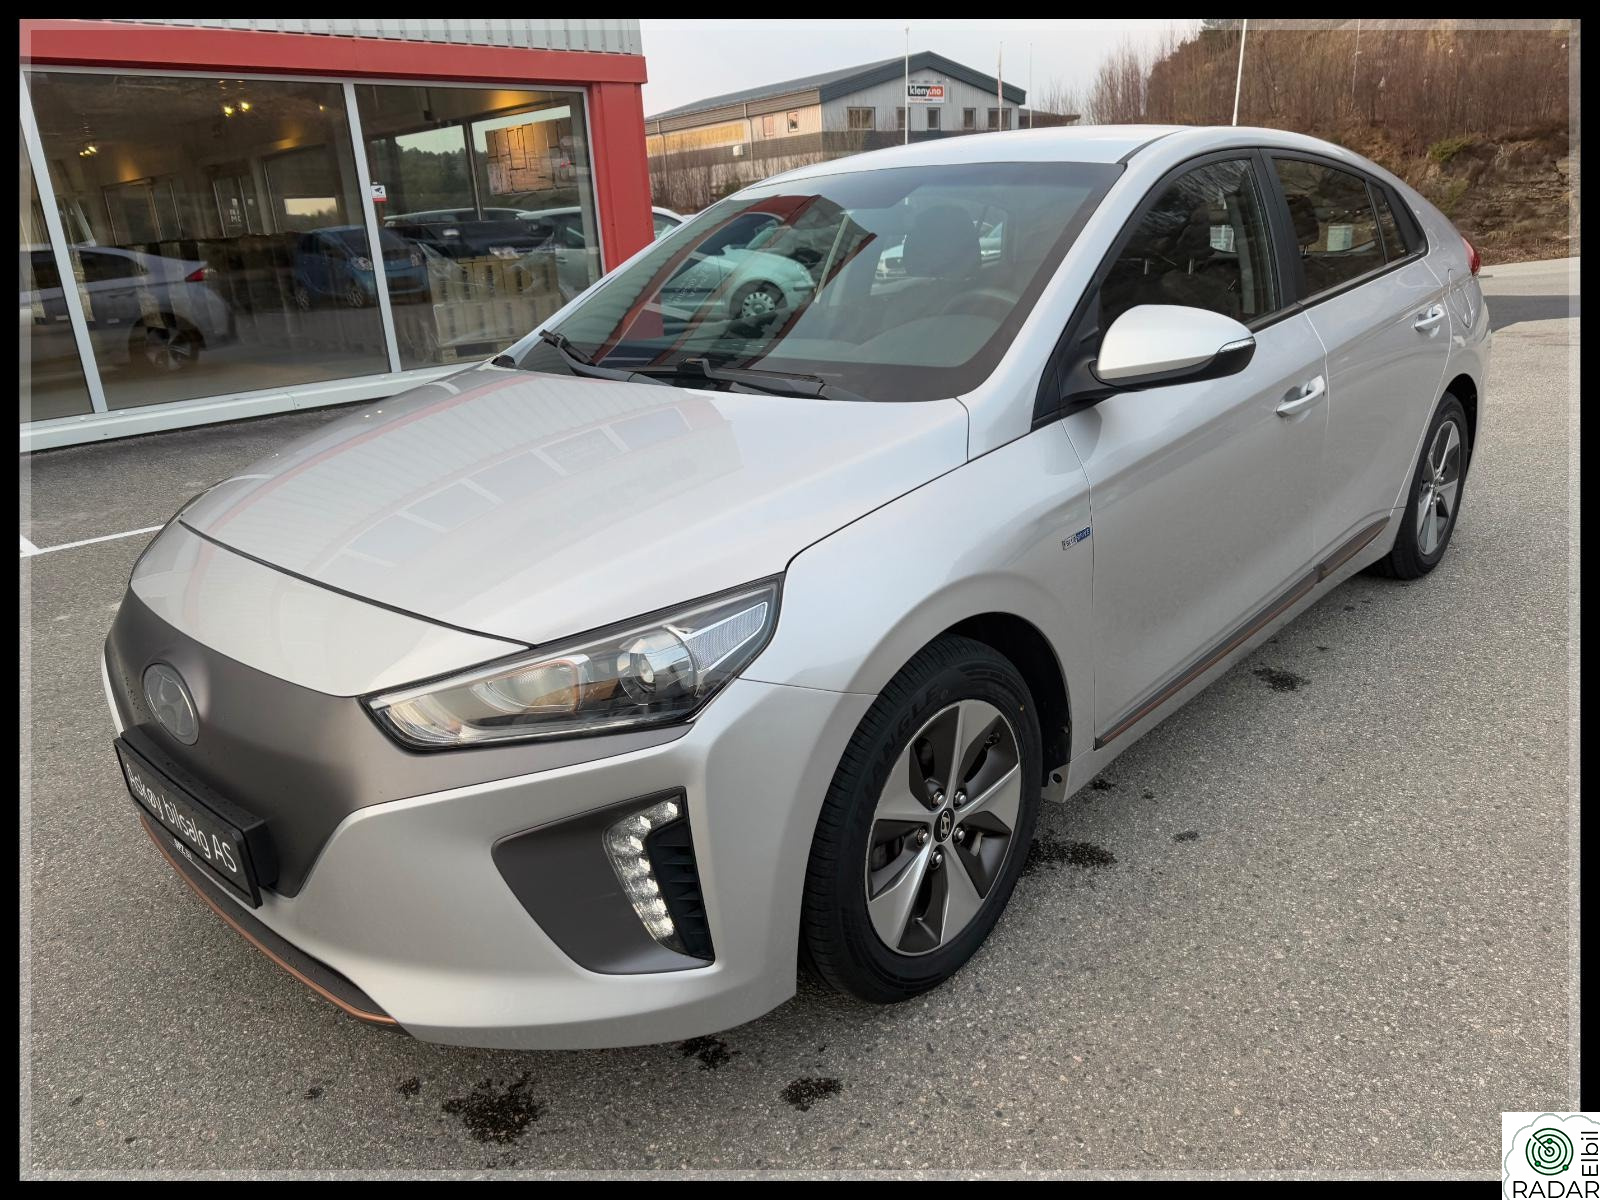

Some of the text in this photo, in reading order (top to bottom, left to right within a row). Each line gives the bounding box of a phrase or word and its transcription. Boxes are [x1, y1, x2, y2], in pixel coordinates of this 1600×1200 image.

[909, 84, 942, 98] kleny.no
[161, 795, 212, 859] bilsalg
[212, 834, 237, 872] AS
